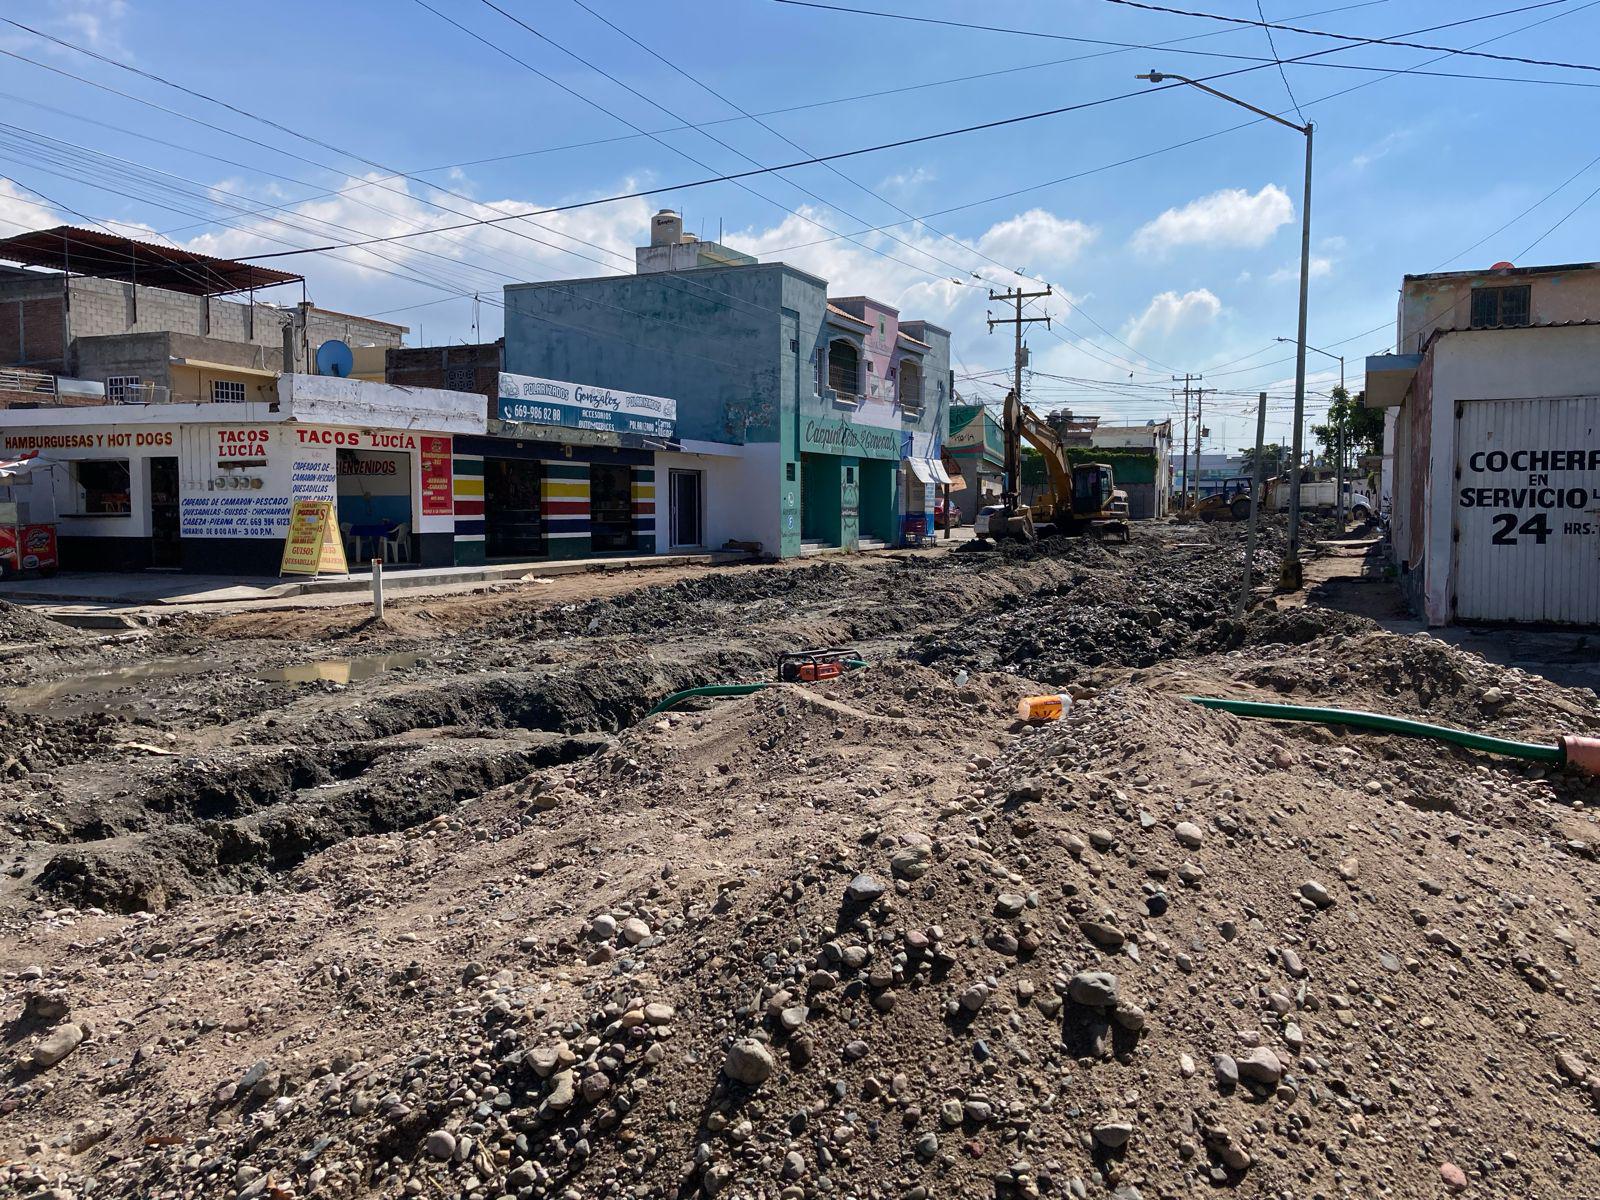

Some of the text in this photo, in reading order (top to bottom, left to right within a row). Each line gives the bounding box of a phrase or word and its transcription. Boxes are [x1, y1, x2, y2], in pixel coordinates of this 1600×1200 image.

[523, 383, 569, 401] POLARIZADOS
[626, 396, 662, 412] POLARIZADOS
[582, 409, 612, 420] ACCESORIOS
[5, 431, 173, 449] HAMBURGUESAS Y HOT DOGS
[218, 430, 269, 442] TACOS
[296, 429, 416, 449] TACOS LUCÍA
[219, 442, 266, 456] LUCÍA
[322, 463, 330, 472] DE
[1529, 474, 1548, 486] EN
[292, 484, 329, 493] QUESADILLAS
[211, 498, 219, 506] DE
[255, 497, 289, 506] PESCADO
[1460, 487, 1588, 509] SERVICIO
[183, 508, 221, 516] QUESADILLAS
[224, 508, 248, 516] GUISOS
[183, 518, 208, 526] CABEZA
[209, 518, 233, 526] PIERNA
[276, 518, 290, 526] 6123
[1491, 513, 1553, 545] 24
[292, 547, 314, 555] GUISOS
